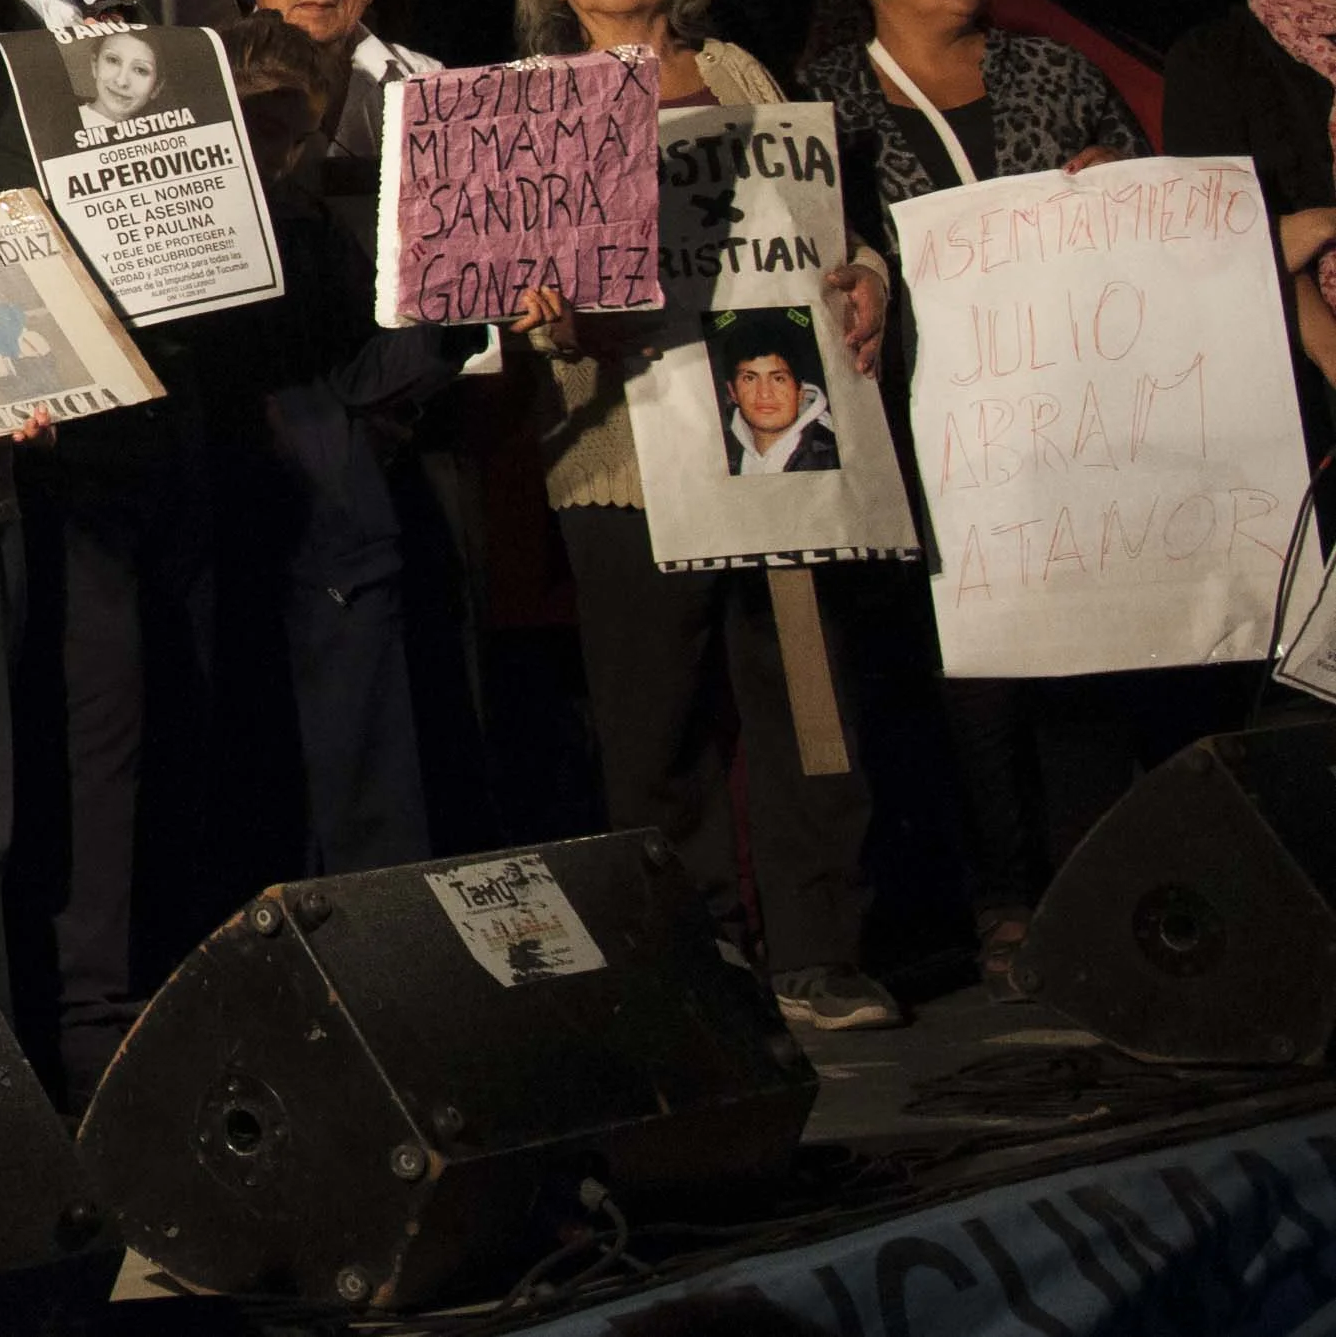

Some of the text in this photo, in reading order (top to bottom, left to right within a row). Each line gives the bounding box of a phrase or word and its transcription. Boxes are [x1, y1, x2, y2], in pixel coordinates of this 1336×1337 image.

[407, 49, 651, 127] JUSTICIA X
[73, 106, 197, 150] SIN JUSTICIA
[98, 135, 187, 165] GOBERNADOR
[469, 114, 629, 174] MAMA
[67, 143, 234, 200] ALPEROVICH:
[84, 175, 226, 219] DIGA EL NOMBRE
[106, 195, 215, 232] DEL ASESINO
[101, 226, 237, 264] Y DEJE DE PROTEGER A
[116, 214, 216, 246] DE PAULINA
[109, 260, 135, 274] LOS
[109, 271, 145, 287] VERDAD
[949, 280, 1147, 387] JULIO
[939, 350, 1213, 498] ABRAM
[955, 486, 1287, 610] ATANOR
